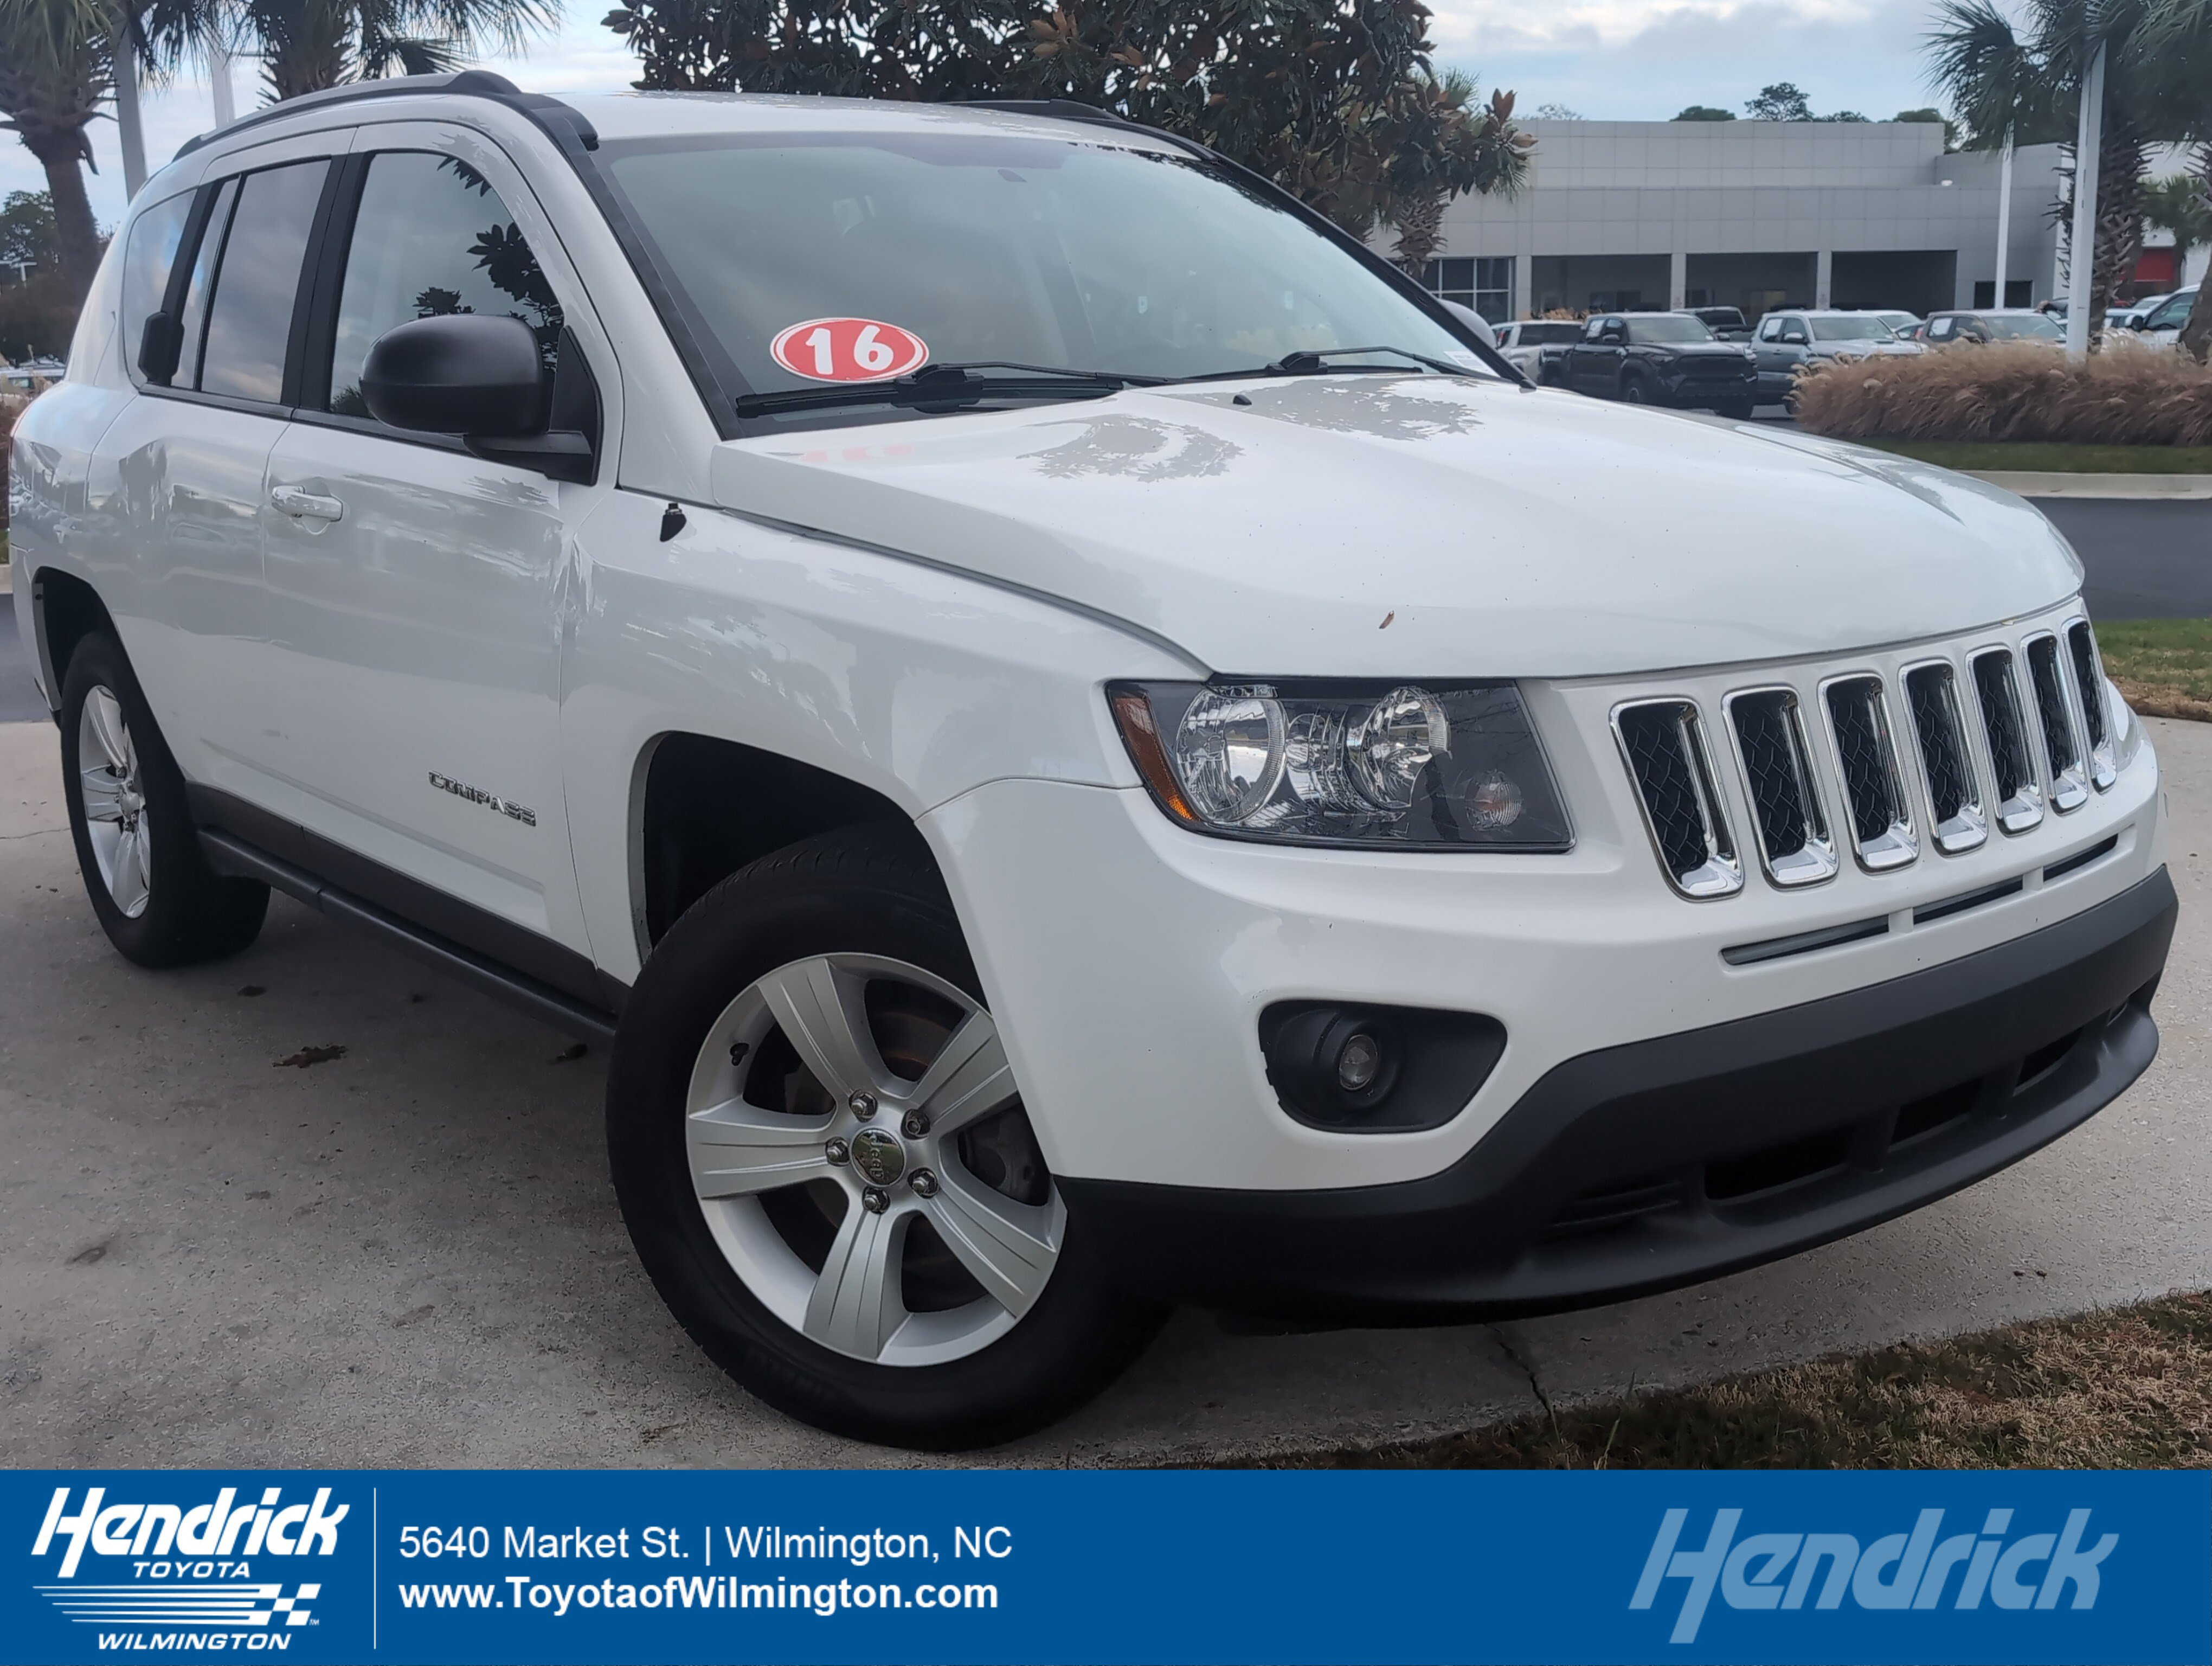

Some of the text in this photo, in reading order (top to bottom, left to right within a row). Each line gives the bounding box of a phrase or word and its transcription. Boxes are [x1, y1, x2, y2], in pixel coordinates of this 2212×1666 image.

[805, 325, 894, 375] 16
[428, 770, 536, 826] COMPASS
[869, 1134, 884, 1179] Jeep
